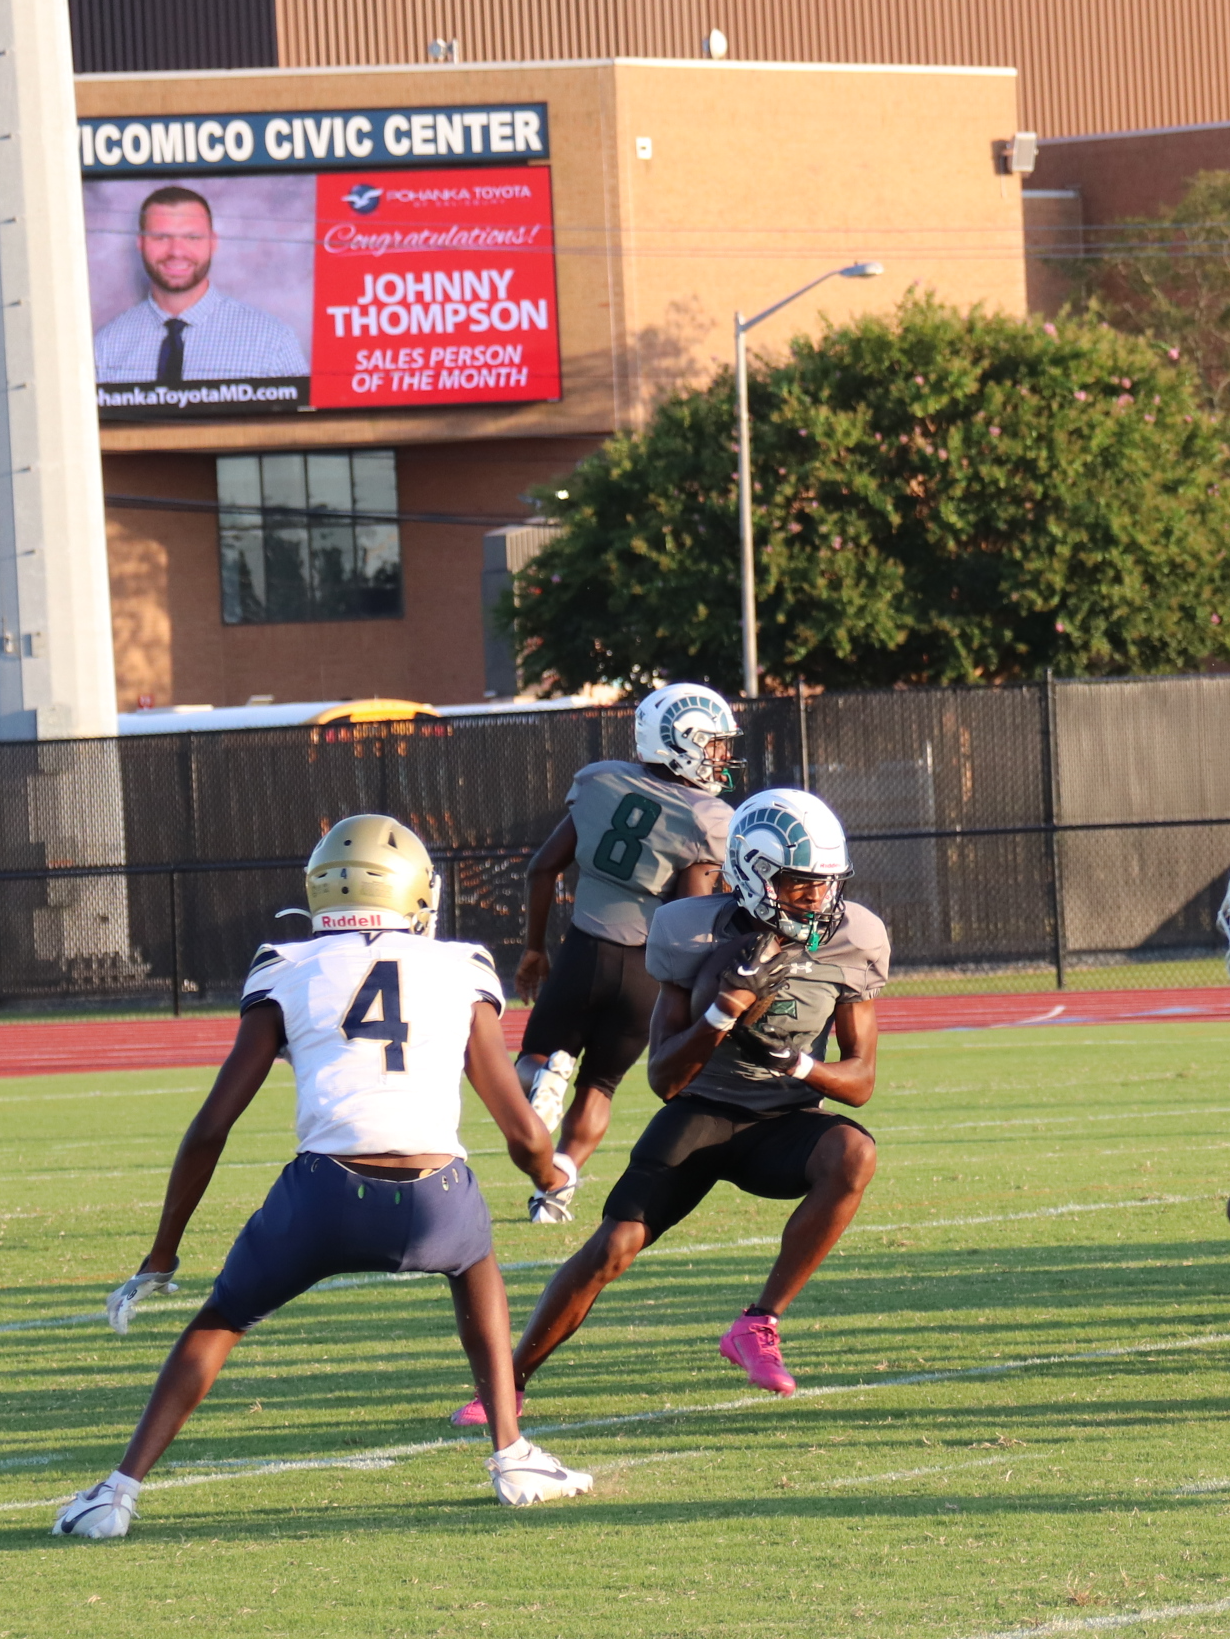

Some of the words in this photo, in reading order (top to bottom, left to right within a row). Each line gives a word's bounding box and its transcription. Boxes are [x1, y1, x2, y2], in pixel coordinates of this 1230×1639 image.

[77, 119, 254, 166] ICOMICO
[264, 115, 373, 160] CIVIC
[383, 111, 543, 156] CENTER
[386, 188, 471, 202] POHANKA
[474, 185, 531, 199] TOYOTA
[324, 223, 542, 256] Congratulations!
[357, 268, 514, 305] JOHNNY
[326, 298, 548, 337] THOMPSON
[355, 347, 424, 370] SALES
[429, 344, 522, 368] PERSON
[352, 372, 383, 392] OF
[391, 370, 433, 391] THE
[438, 366, 528, 389] MONTH
[97, 384, 298, 408] hankaToyotaMD.com
[593, 792, 662, 882] 8
[340, 868, 348, 880] 4
[321, 914, 382, 928] Riddell
[338, 958, 411, 1075] 4
